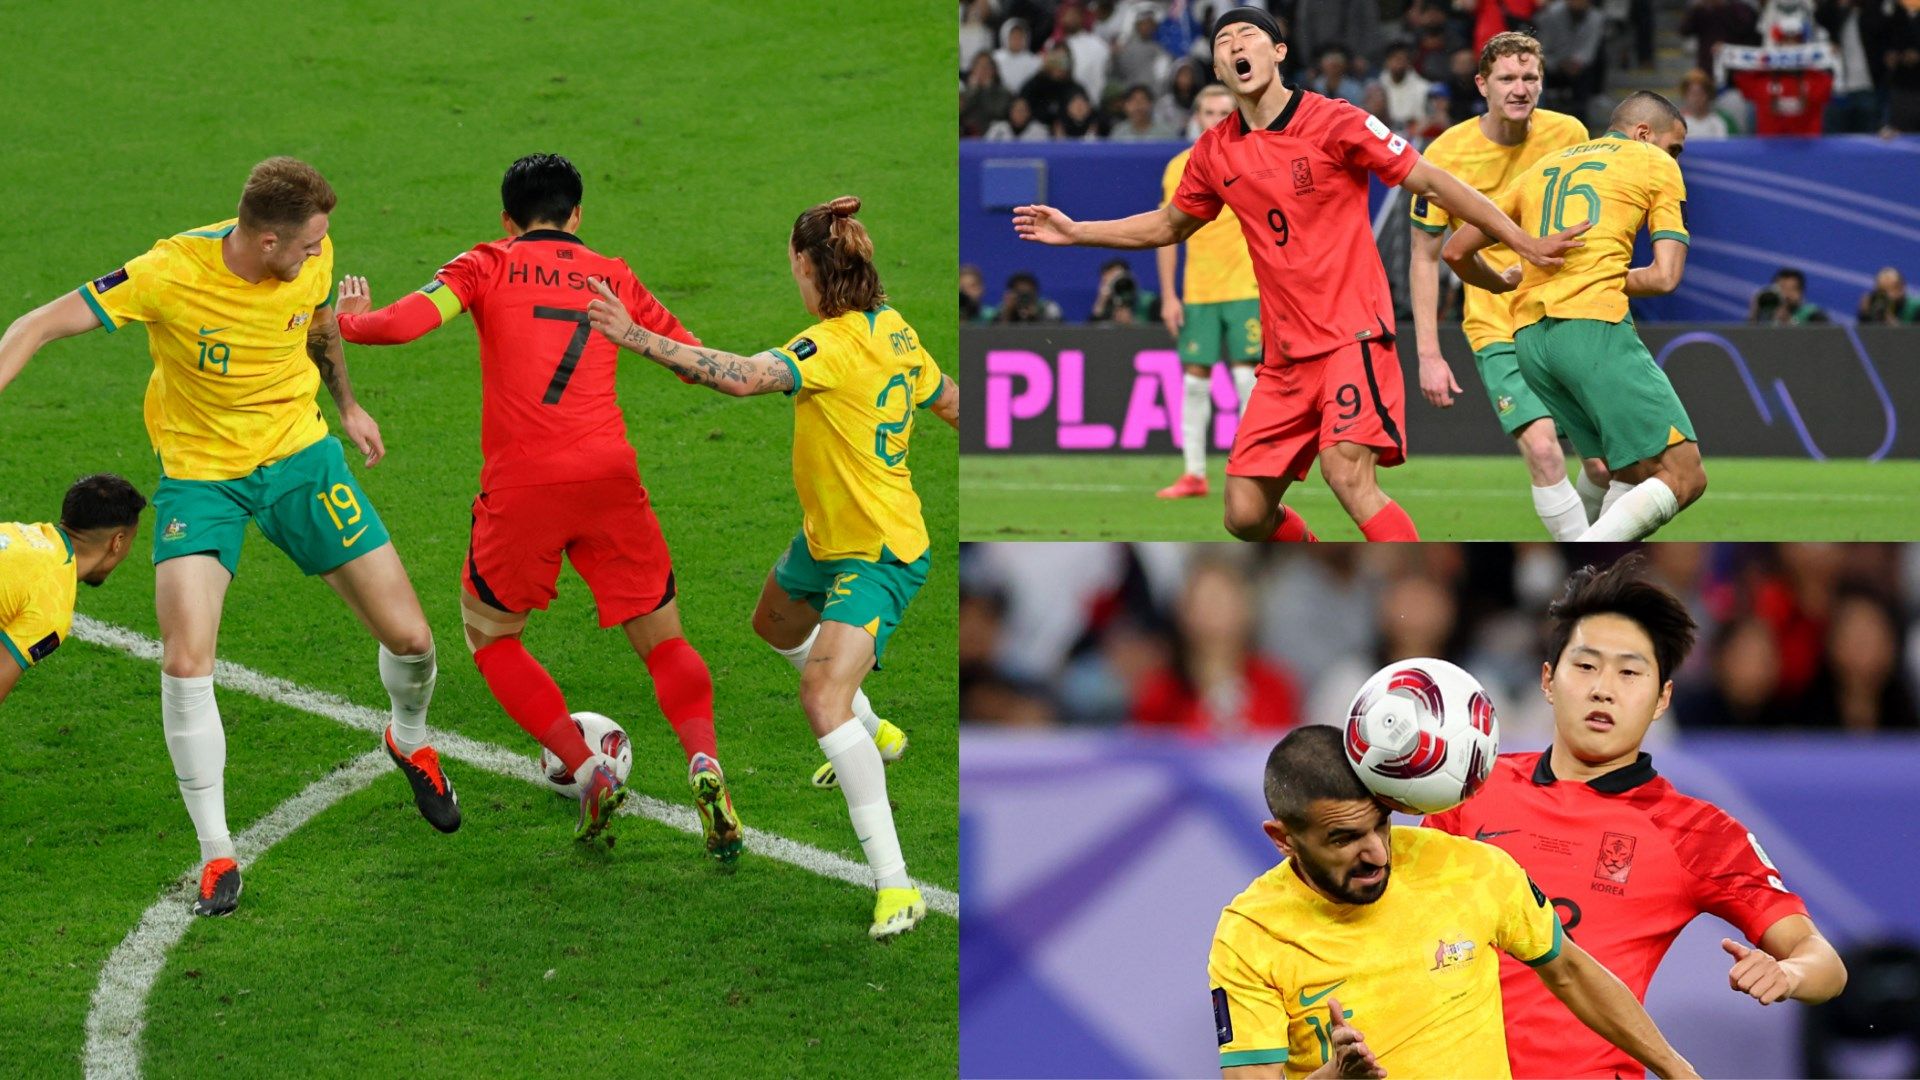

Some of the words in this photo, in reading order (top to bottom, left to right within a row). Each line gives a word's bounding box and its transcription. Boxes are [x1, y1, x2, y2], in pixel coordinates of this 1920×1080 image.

[1540, 161, 1608, 238] 16
[1267, 208, 1289, 247] 9
[197, 340, 231, 375] 19
[533, 305, 592, 405] 7
[1335, 383, 1361, 420] 9
[317, 482, 362, 531] 19
[1590, 881, 1625, 897] KOREA
